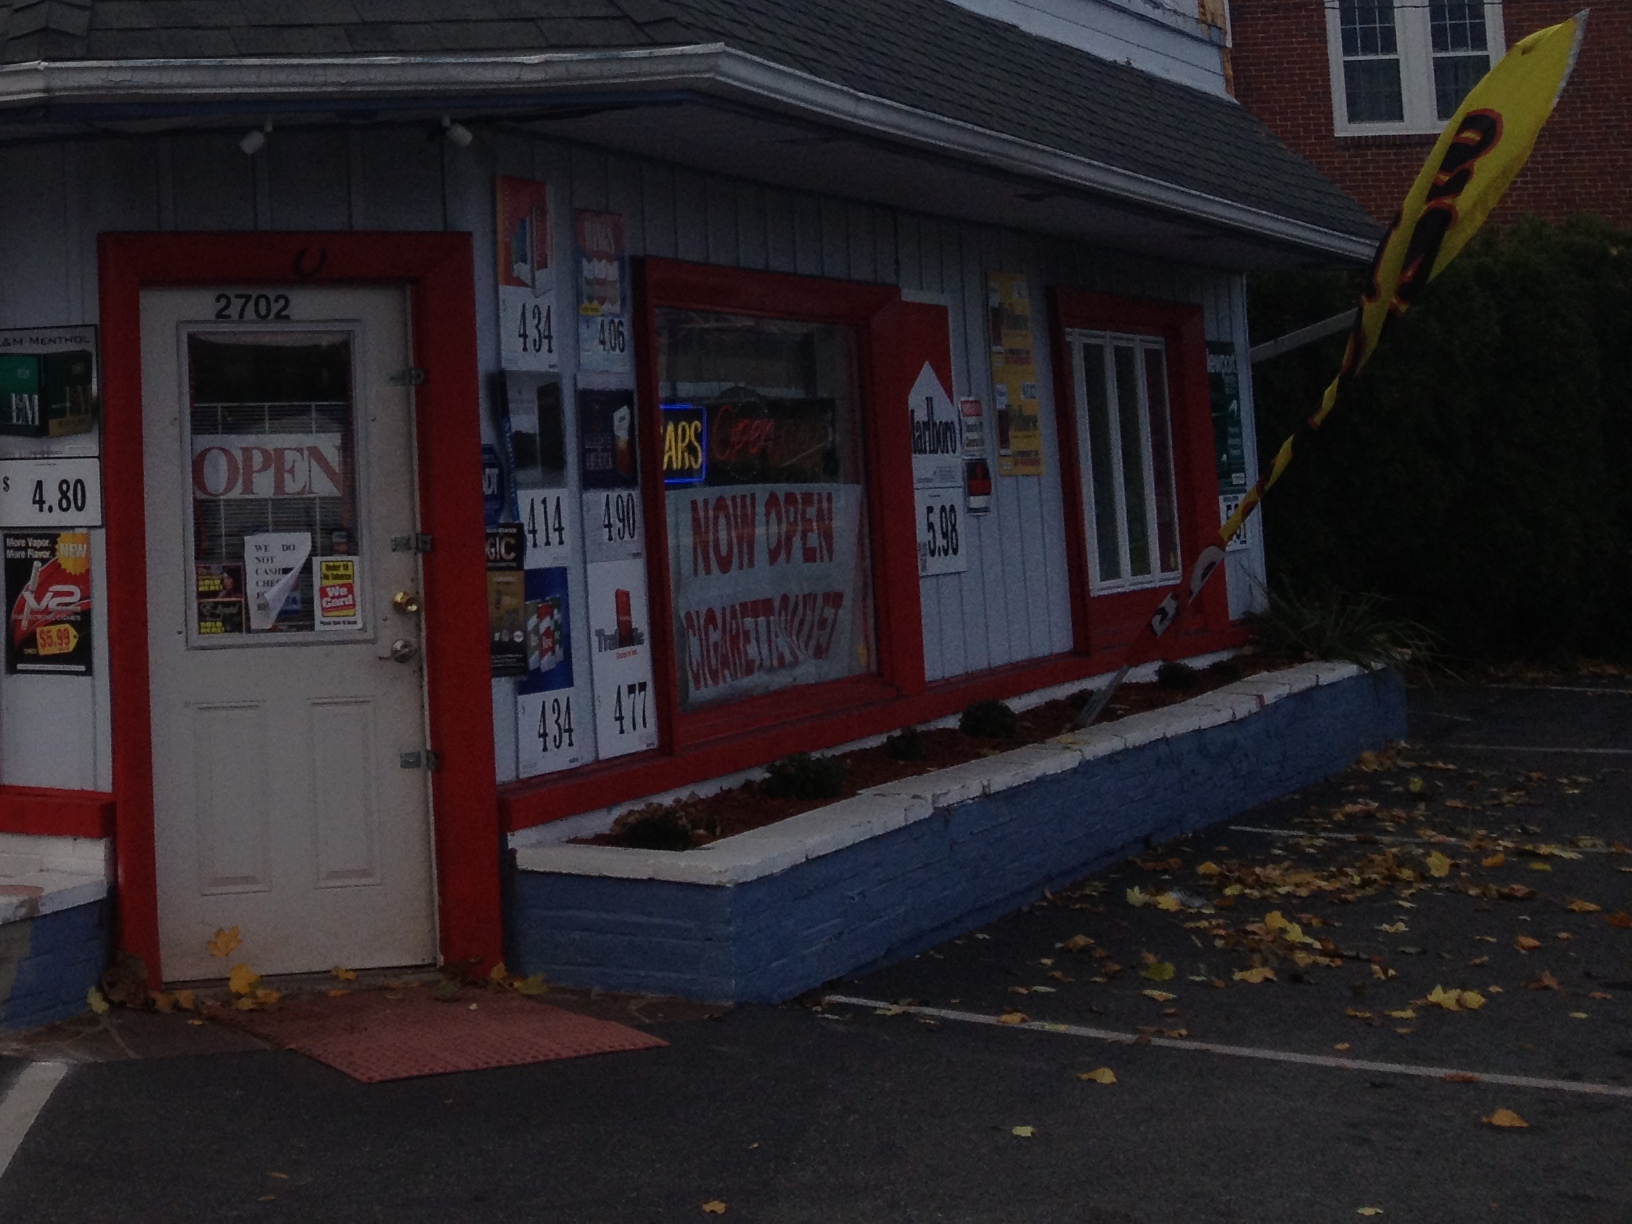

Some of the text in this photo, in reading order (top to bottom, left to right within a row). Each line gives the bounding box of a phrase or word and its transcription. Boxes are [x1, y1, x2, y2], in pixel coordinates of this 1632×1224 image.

[214, 293, 291, 320] 2702
[29, 335, 90, 346] MENTHOL
[192, 445, 343, 497] OPEN
[32, 478, 87, 514] 4.80
[690, 491, 834, 577] NOW OPEN
[926, 504, 960, 558] 5.98
[6, 537, 52, 549] More Vapor.
[254, 543, 296, 553] WE DO
[6, 549, 26, 559] More
[59, 543, 87, 558] NEW
[255, 555, 275, 564] NOT
[325, 586, 348, 597] We
[322, 594, 354, 608] Card
[39, 628, 71, 648] $5.99
